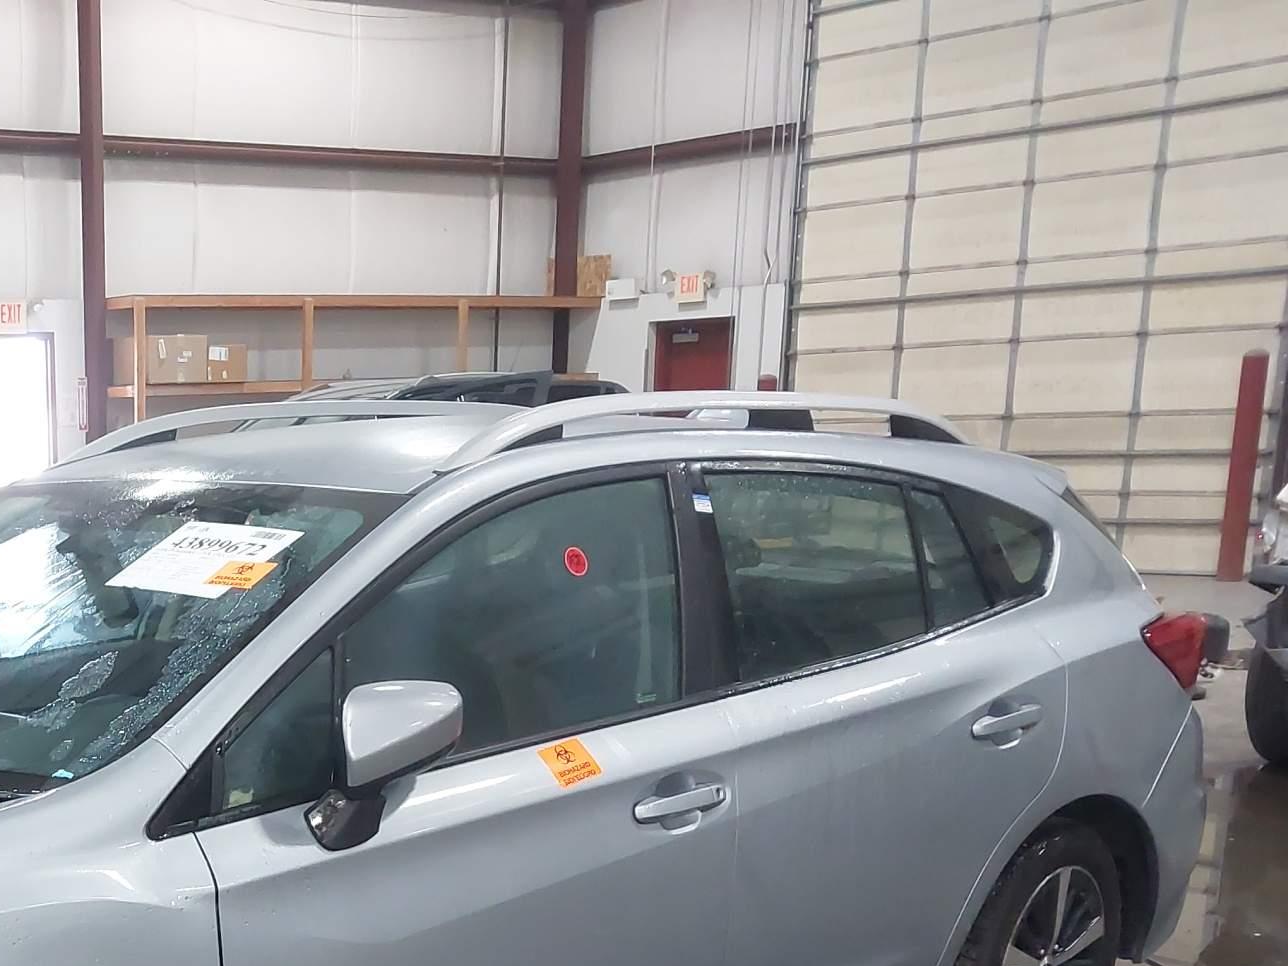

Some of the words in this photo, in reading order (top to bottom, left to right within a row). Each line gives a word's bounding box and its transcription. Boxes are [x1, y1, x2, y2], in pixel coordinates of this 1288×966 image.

[680, 275, 699, 294] EXIT
[0, 303, 21, 324] EXIT
[171, 536, 268, 556] 43899672
